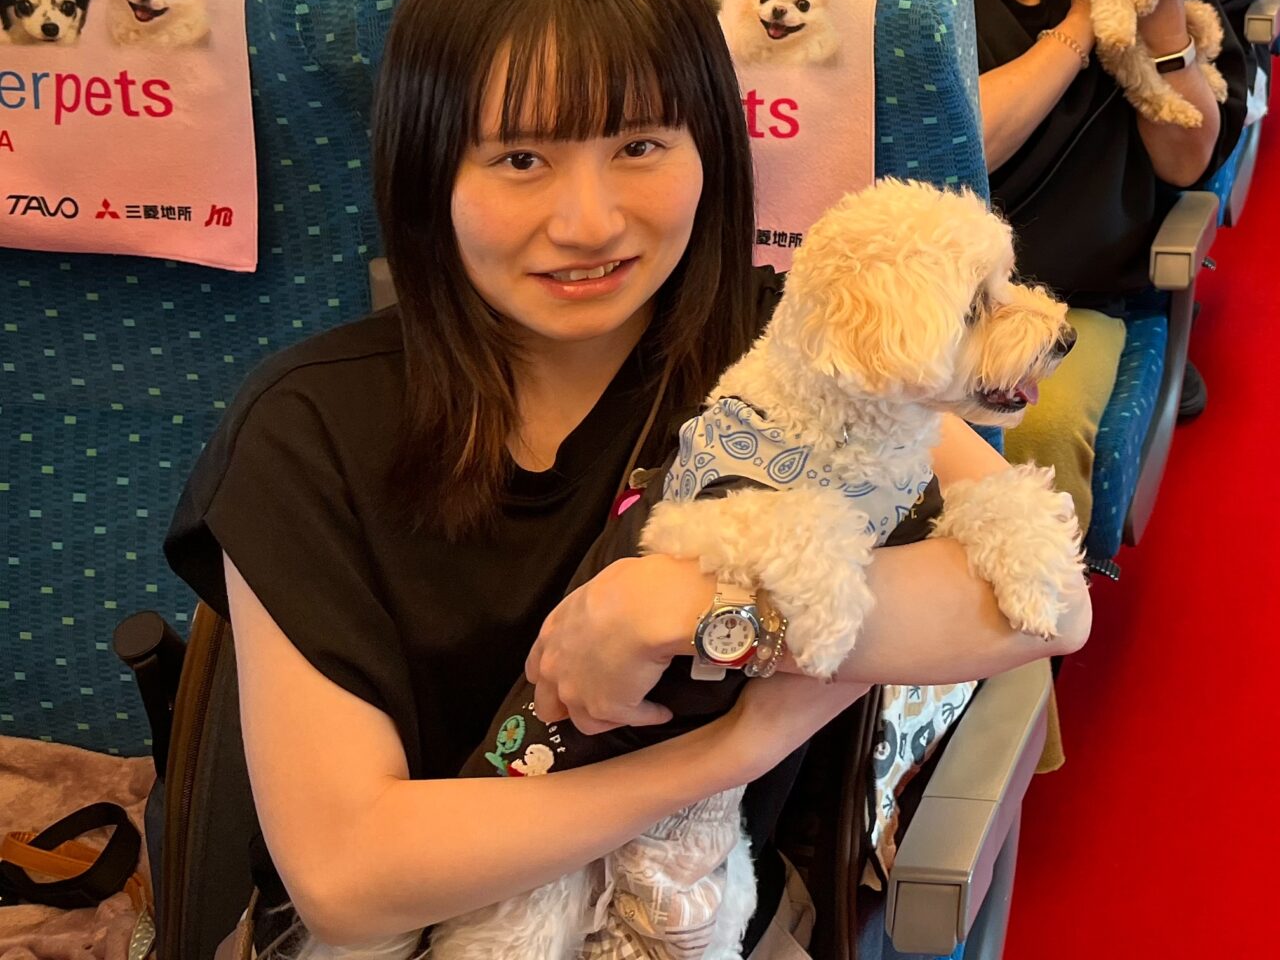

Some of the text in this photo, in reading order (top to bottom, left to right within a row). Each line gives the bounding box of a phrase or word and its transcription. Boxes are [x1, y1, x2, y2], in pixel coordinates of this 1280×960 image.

[0, 70, 174, 125] erpets
[6, 195, 233, 227] TAVO 三菱地所 JTB
[756, 229, 803, 249] 菱地所
